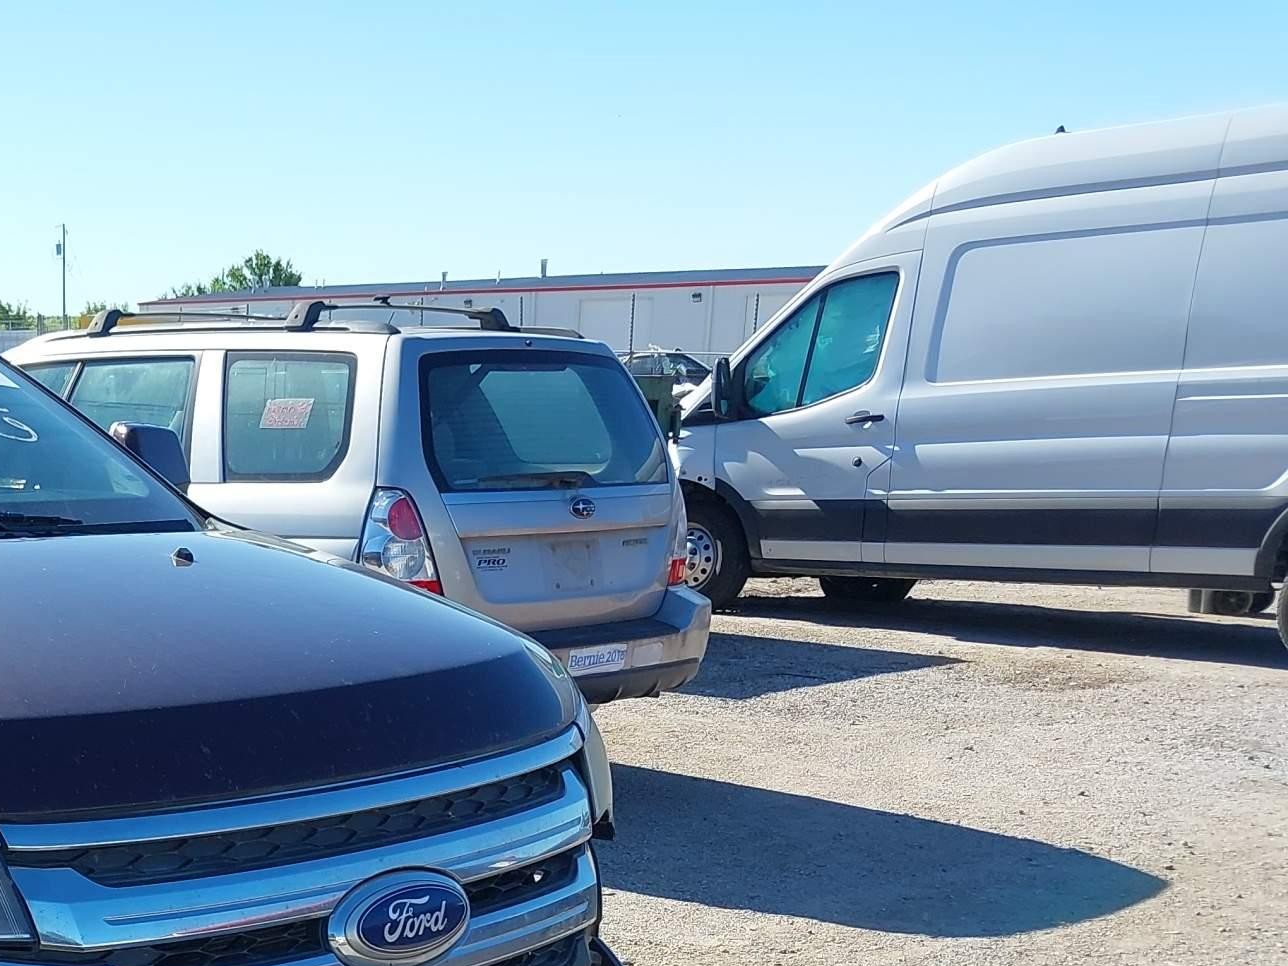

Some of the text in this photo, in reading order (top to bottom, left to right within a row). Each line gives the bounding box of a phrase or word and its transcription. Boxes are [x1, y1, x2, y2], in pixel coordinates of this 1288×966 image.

[477, 558, 506, 566] PRO
[570, 652, 605, 667] Bernie
[383, 895, 448, 943] Ford
